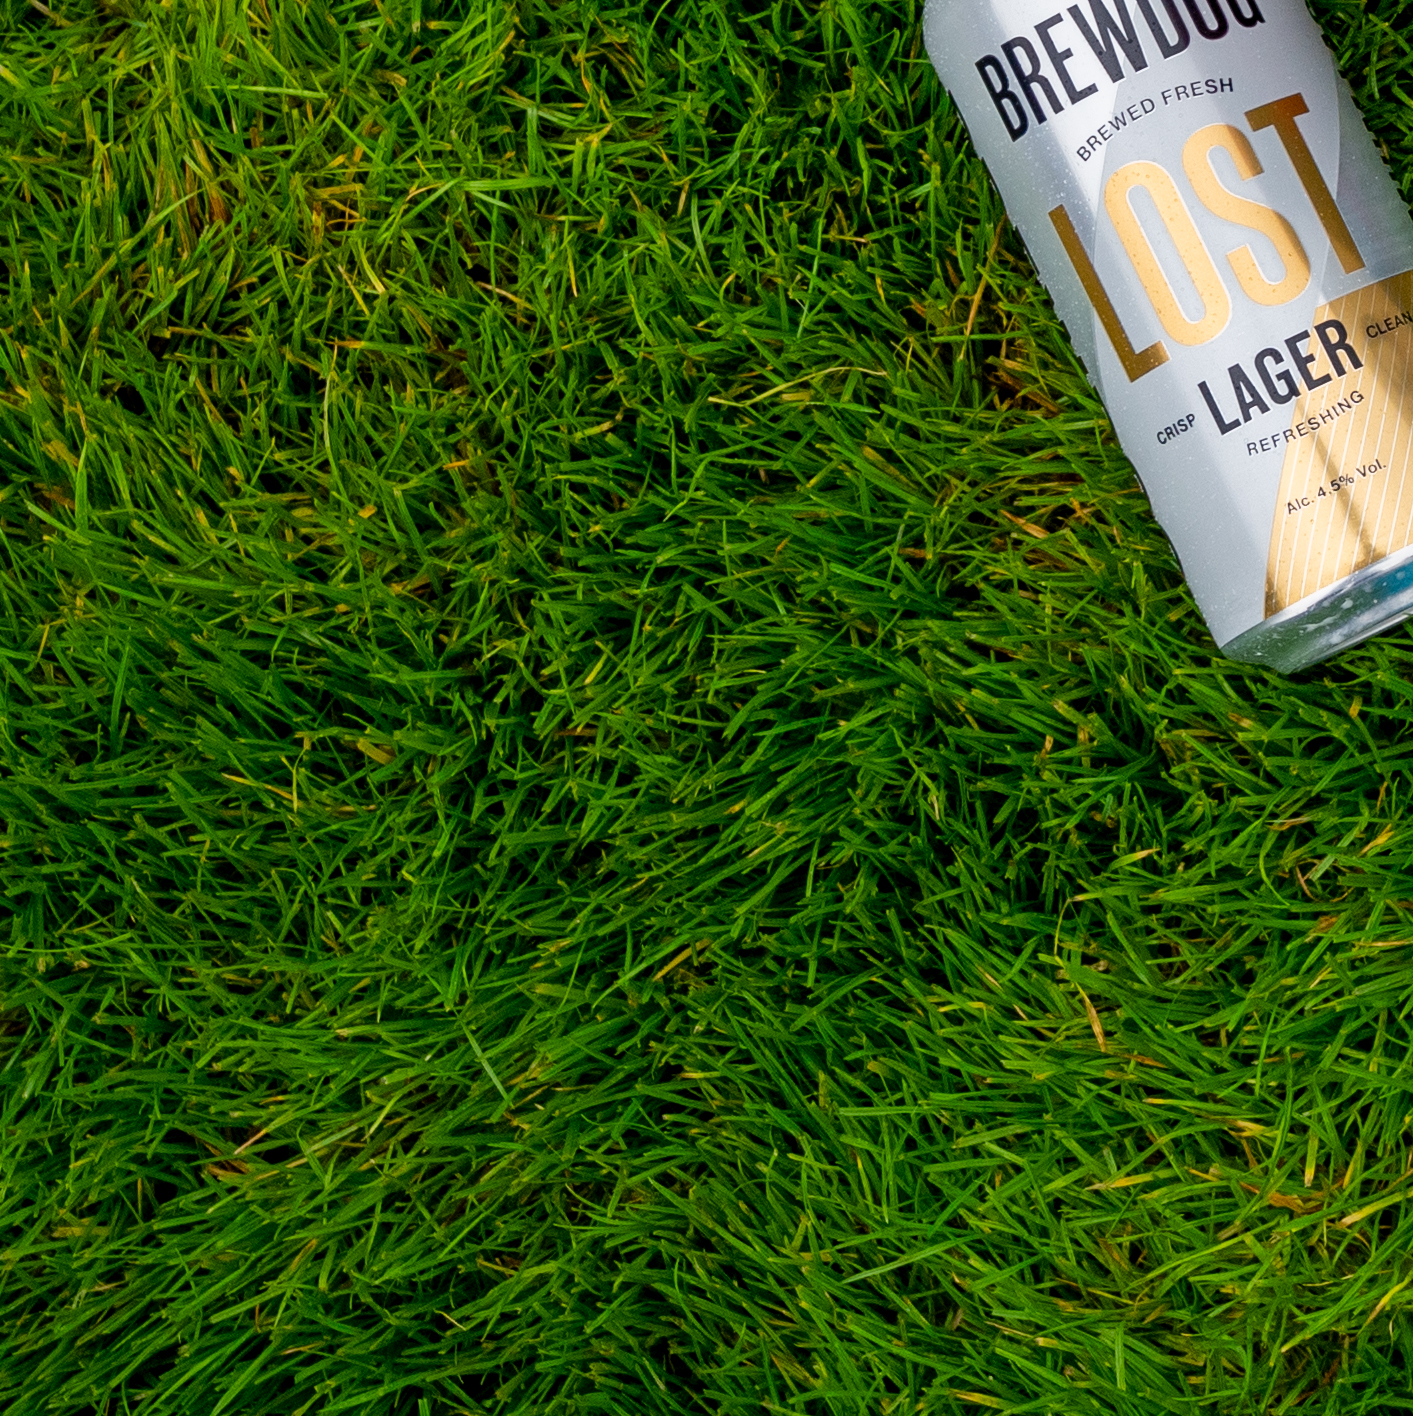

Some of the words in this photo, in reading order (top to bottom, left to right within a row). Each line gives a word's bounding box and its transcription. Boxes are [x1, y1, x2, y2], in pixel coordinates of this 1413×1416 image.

[1076, 98, 1156, 162] BREWED
[1161, 77, 1234, 106] FRESH
[1048, 92, 1367, 384] LOST
[1156, 413, 1196, 445] CRISP
[1197, 319, 1364, 435] LAGER
[1366, 311, 1413, 339] CLEAN
[1247, 390, 1365, 456] REFRESHING
[1286, 496, 1315, 515] Alc.
[1317, 474, 1355, 498] 4.5%
[1355, 458, 1387, 479] Vol.
